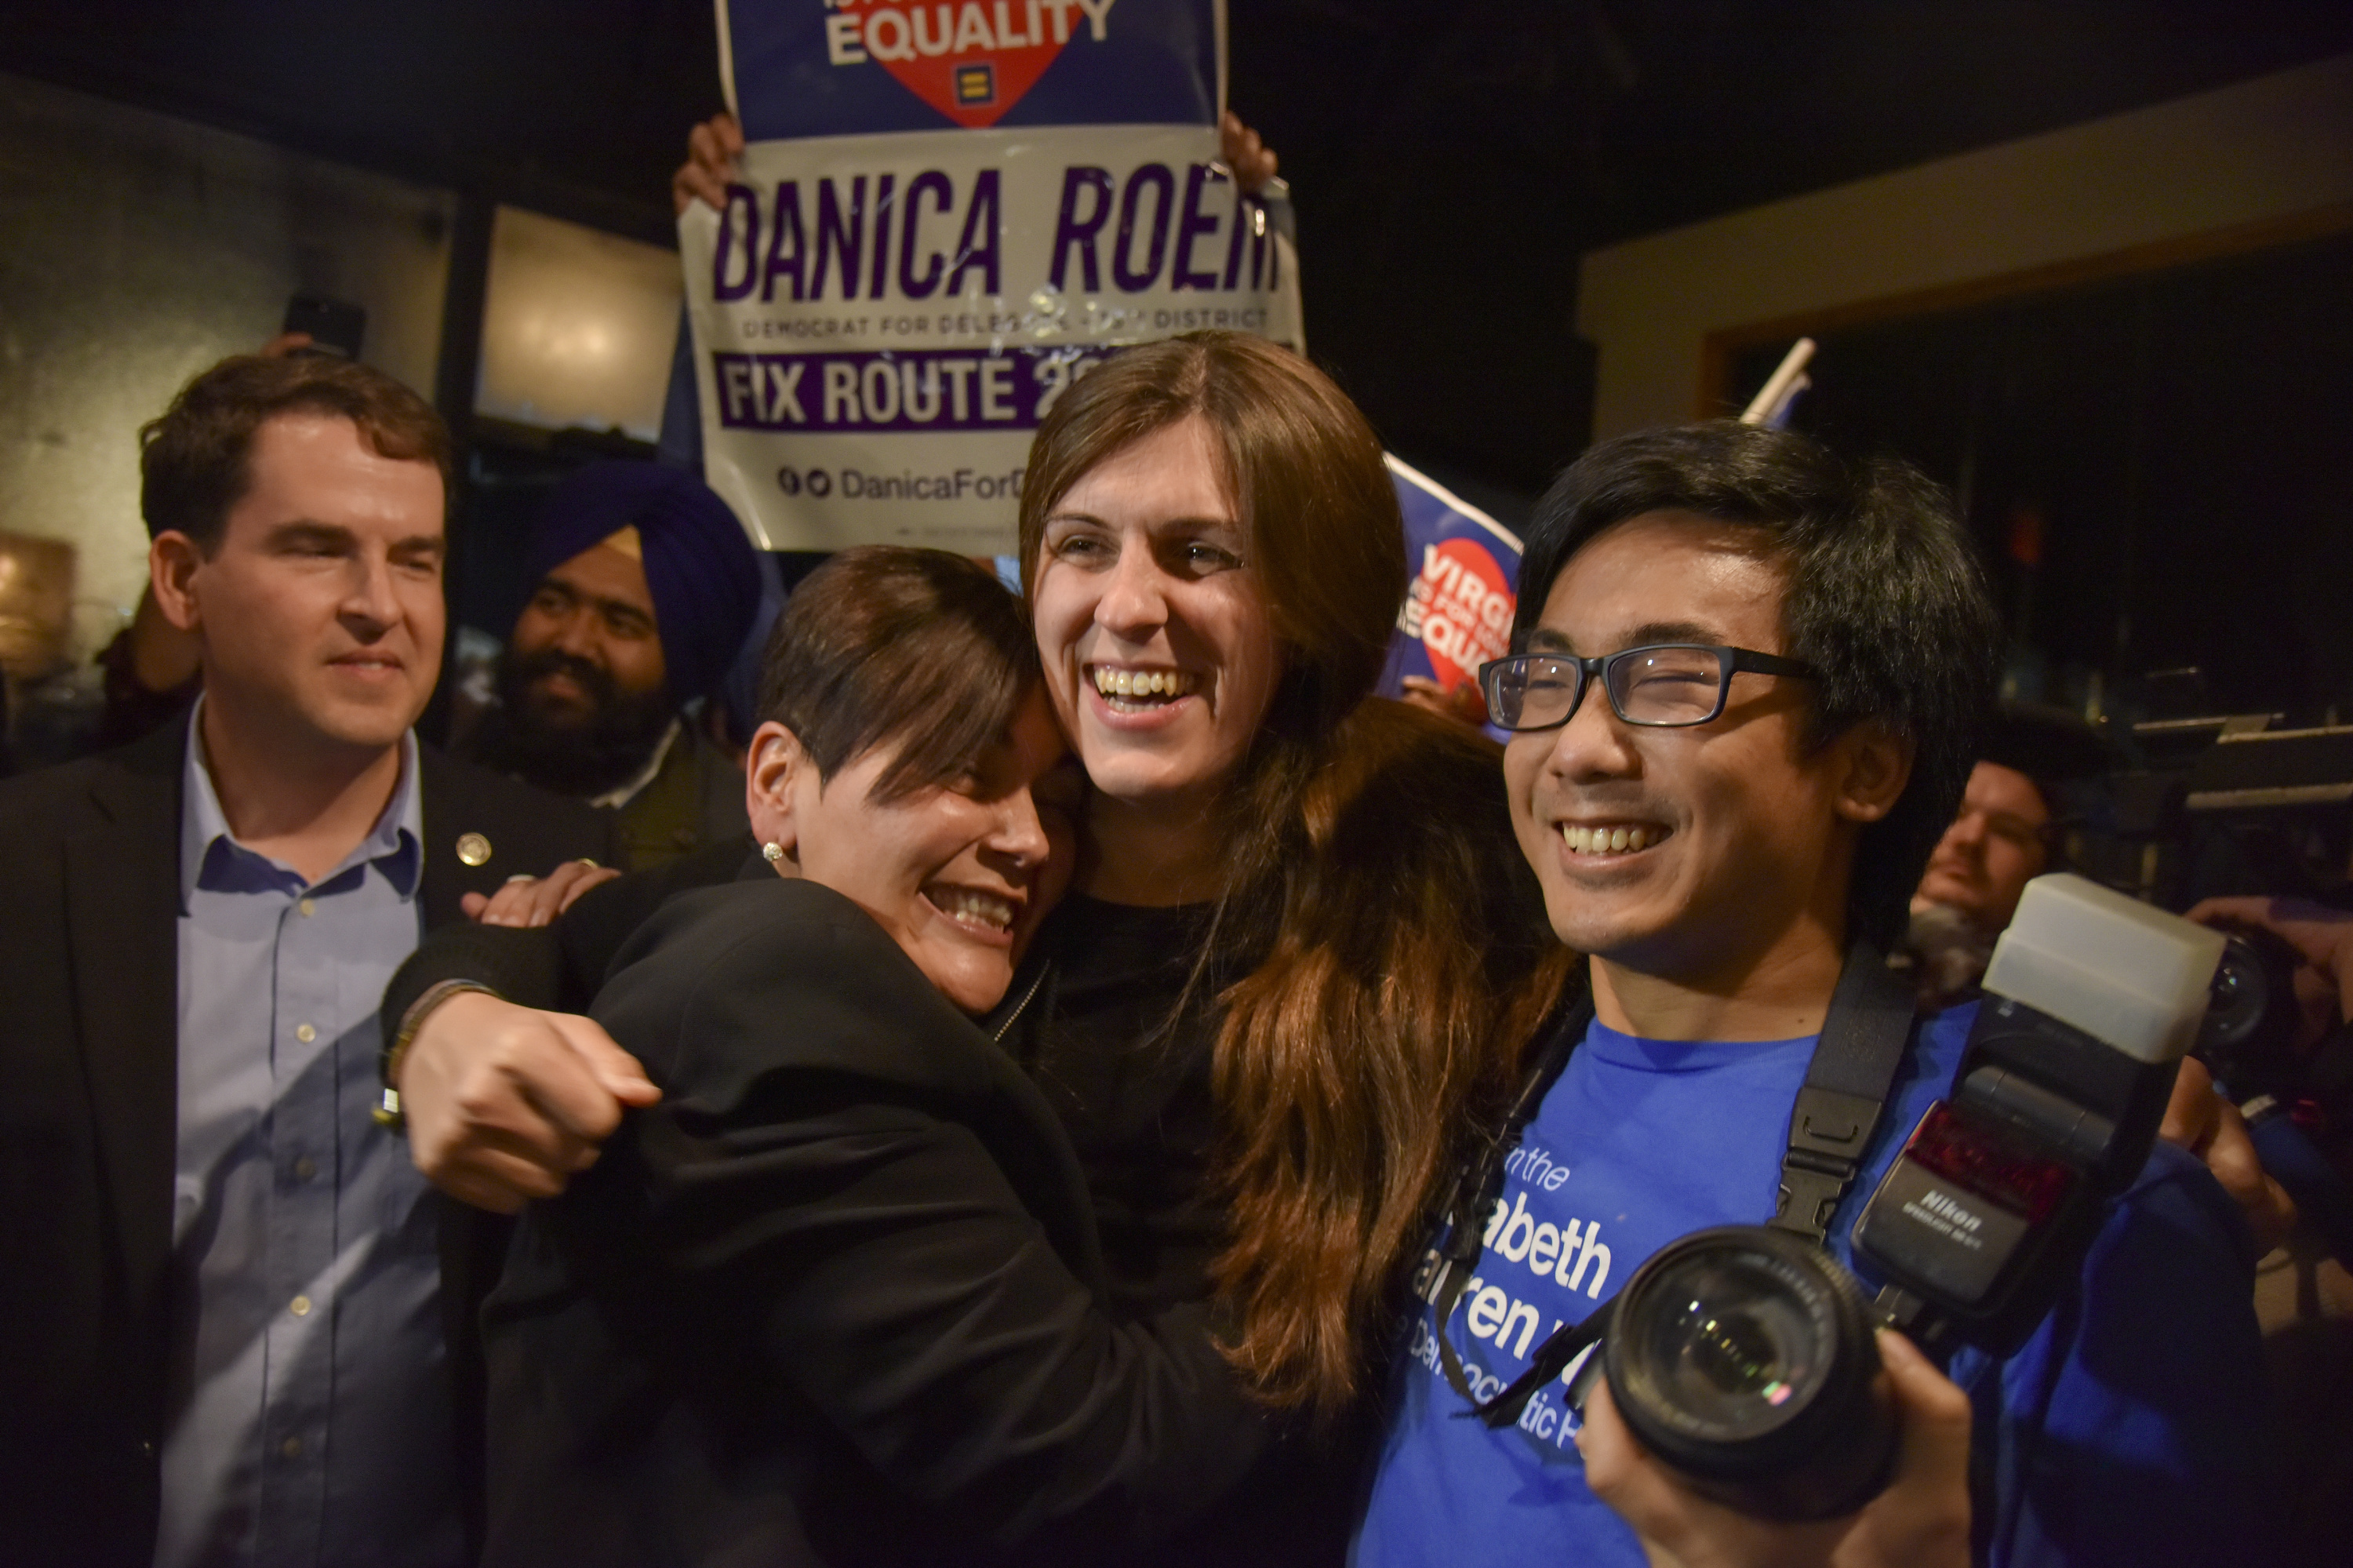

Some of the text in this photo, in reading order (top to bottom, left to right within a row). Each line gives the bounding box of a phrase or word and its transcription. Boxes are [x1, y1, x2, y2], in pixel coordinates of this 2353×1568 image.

[826, 0, 1115, 66] EQUALITY
[713, 168, 1001, 303] DANICA
[743, 316, 869, 339] DEMOCRAT
[880, 315, 929, 336] FOR
[1154, 308, 1269, 329] DISTRICT
[723, 358, 1100, 424] FIX ROUTE 2
[1522, 1147, 1571, 1191] the
[1920, 1189, 1982, 1232] Nikon
[1482, 1191, 1612, 1300] abeth
